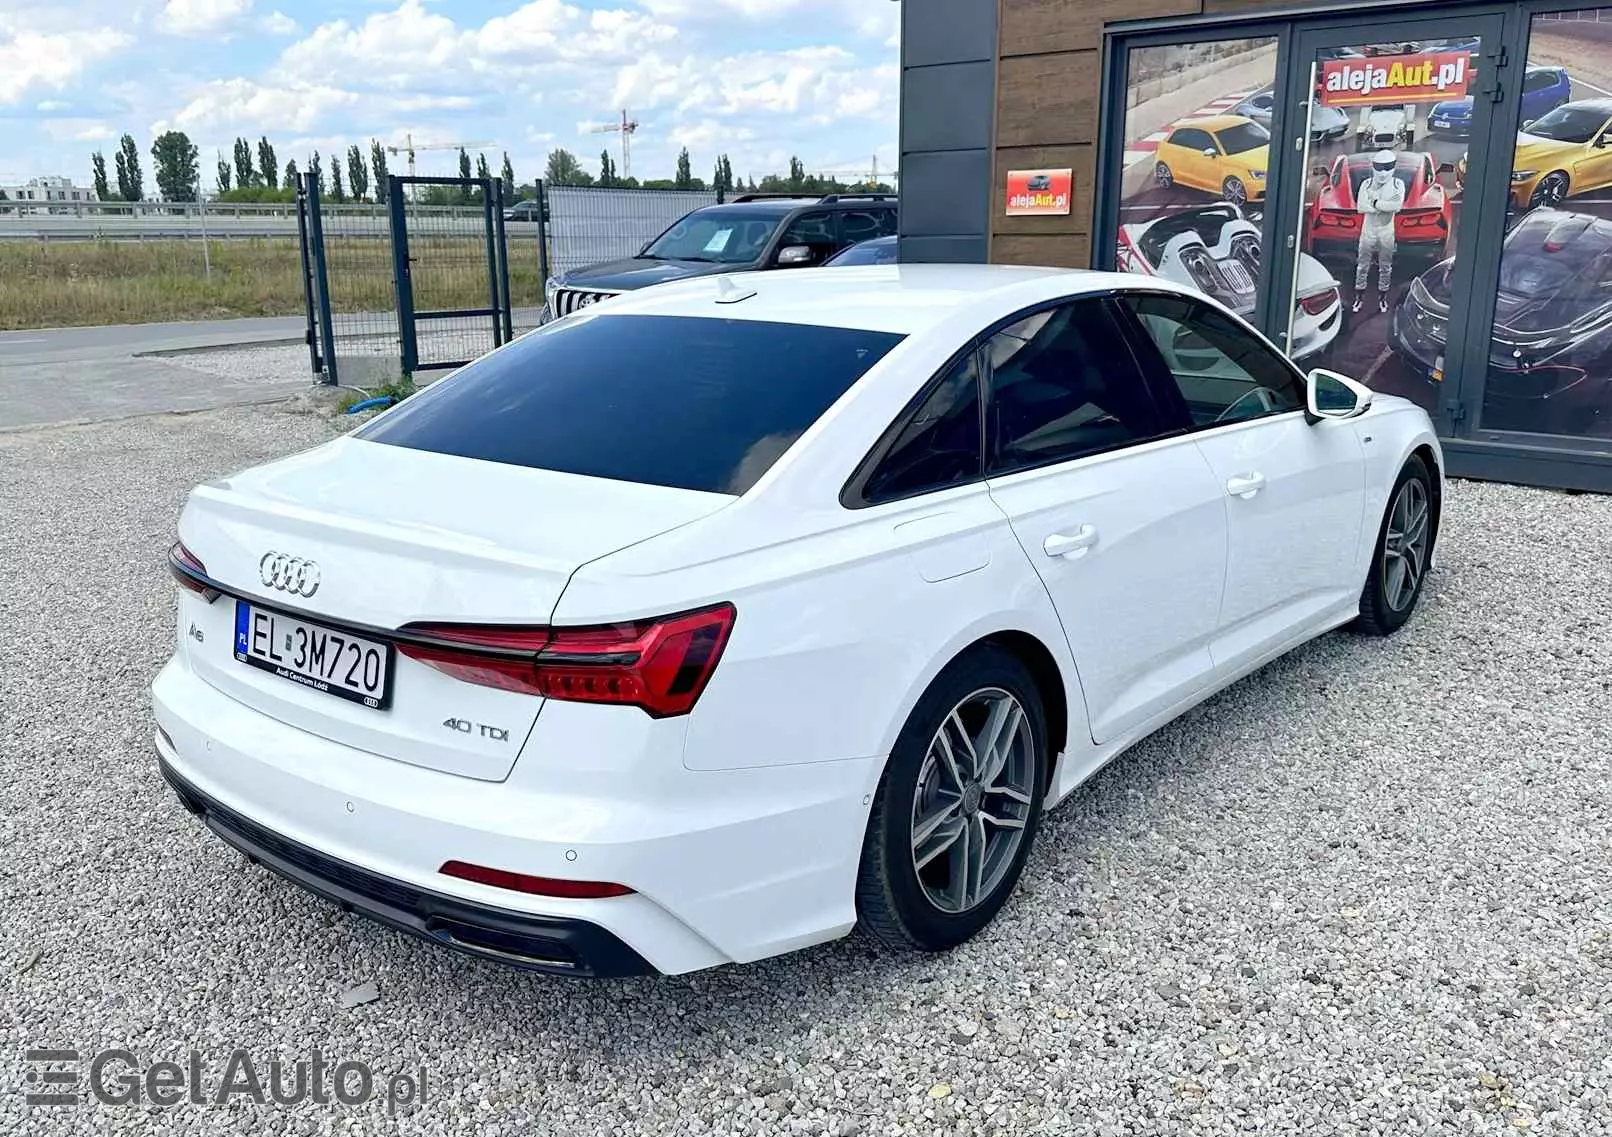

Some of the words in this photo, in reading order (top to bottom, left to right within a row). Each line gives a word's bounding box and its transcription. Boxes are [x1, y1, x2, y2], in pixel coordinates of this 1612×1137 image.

[1326, 57, 1465, 95] alejaAut.pl
[1009, 192, 1067, 209] alejaAut.pl
[239, 632, 248, 645] PL
[253, 612, 283, 662] EL
[294, 627, 380, 692] 3M720
[276, 667, 289, 677] Audi
[290, 671, 313, 686] Centrum
[443, 717, 472, 734] 40
[476, 723, 509, 742] TDI
